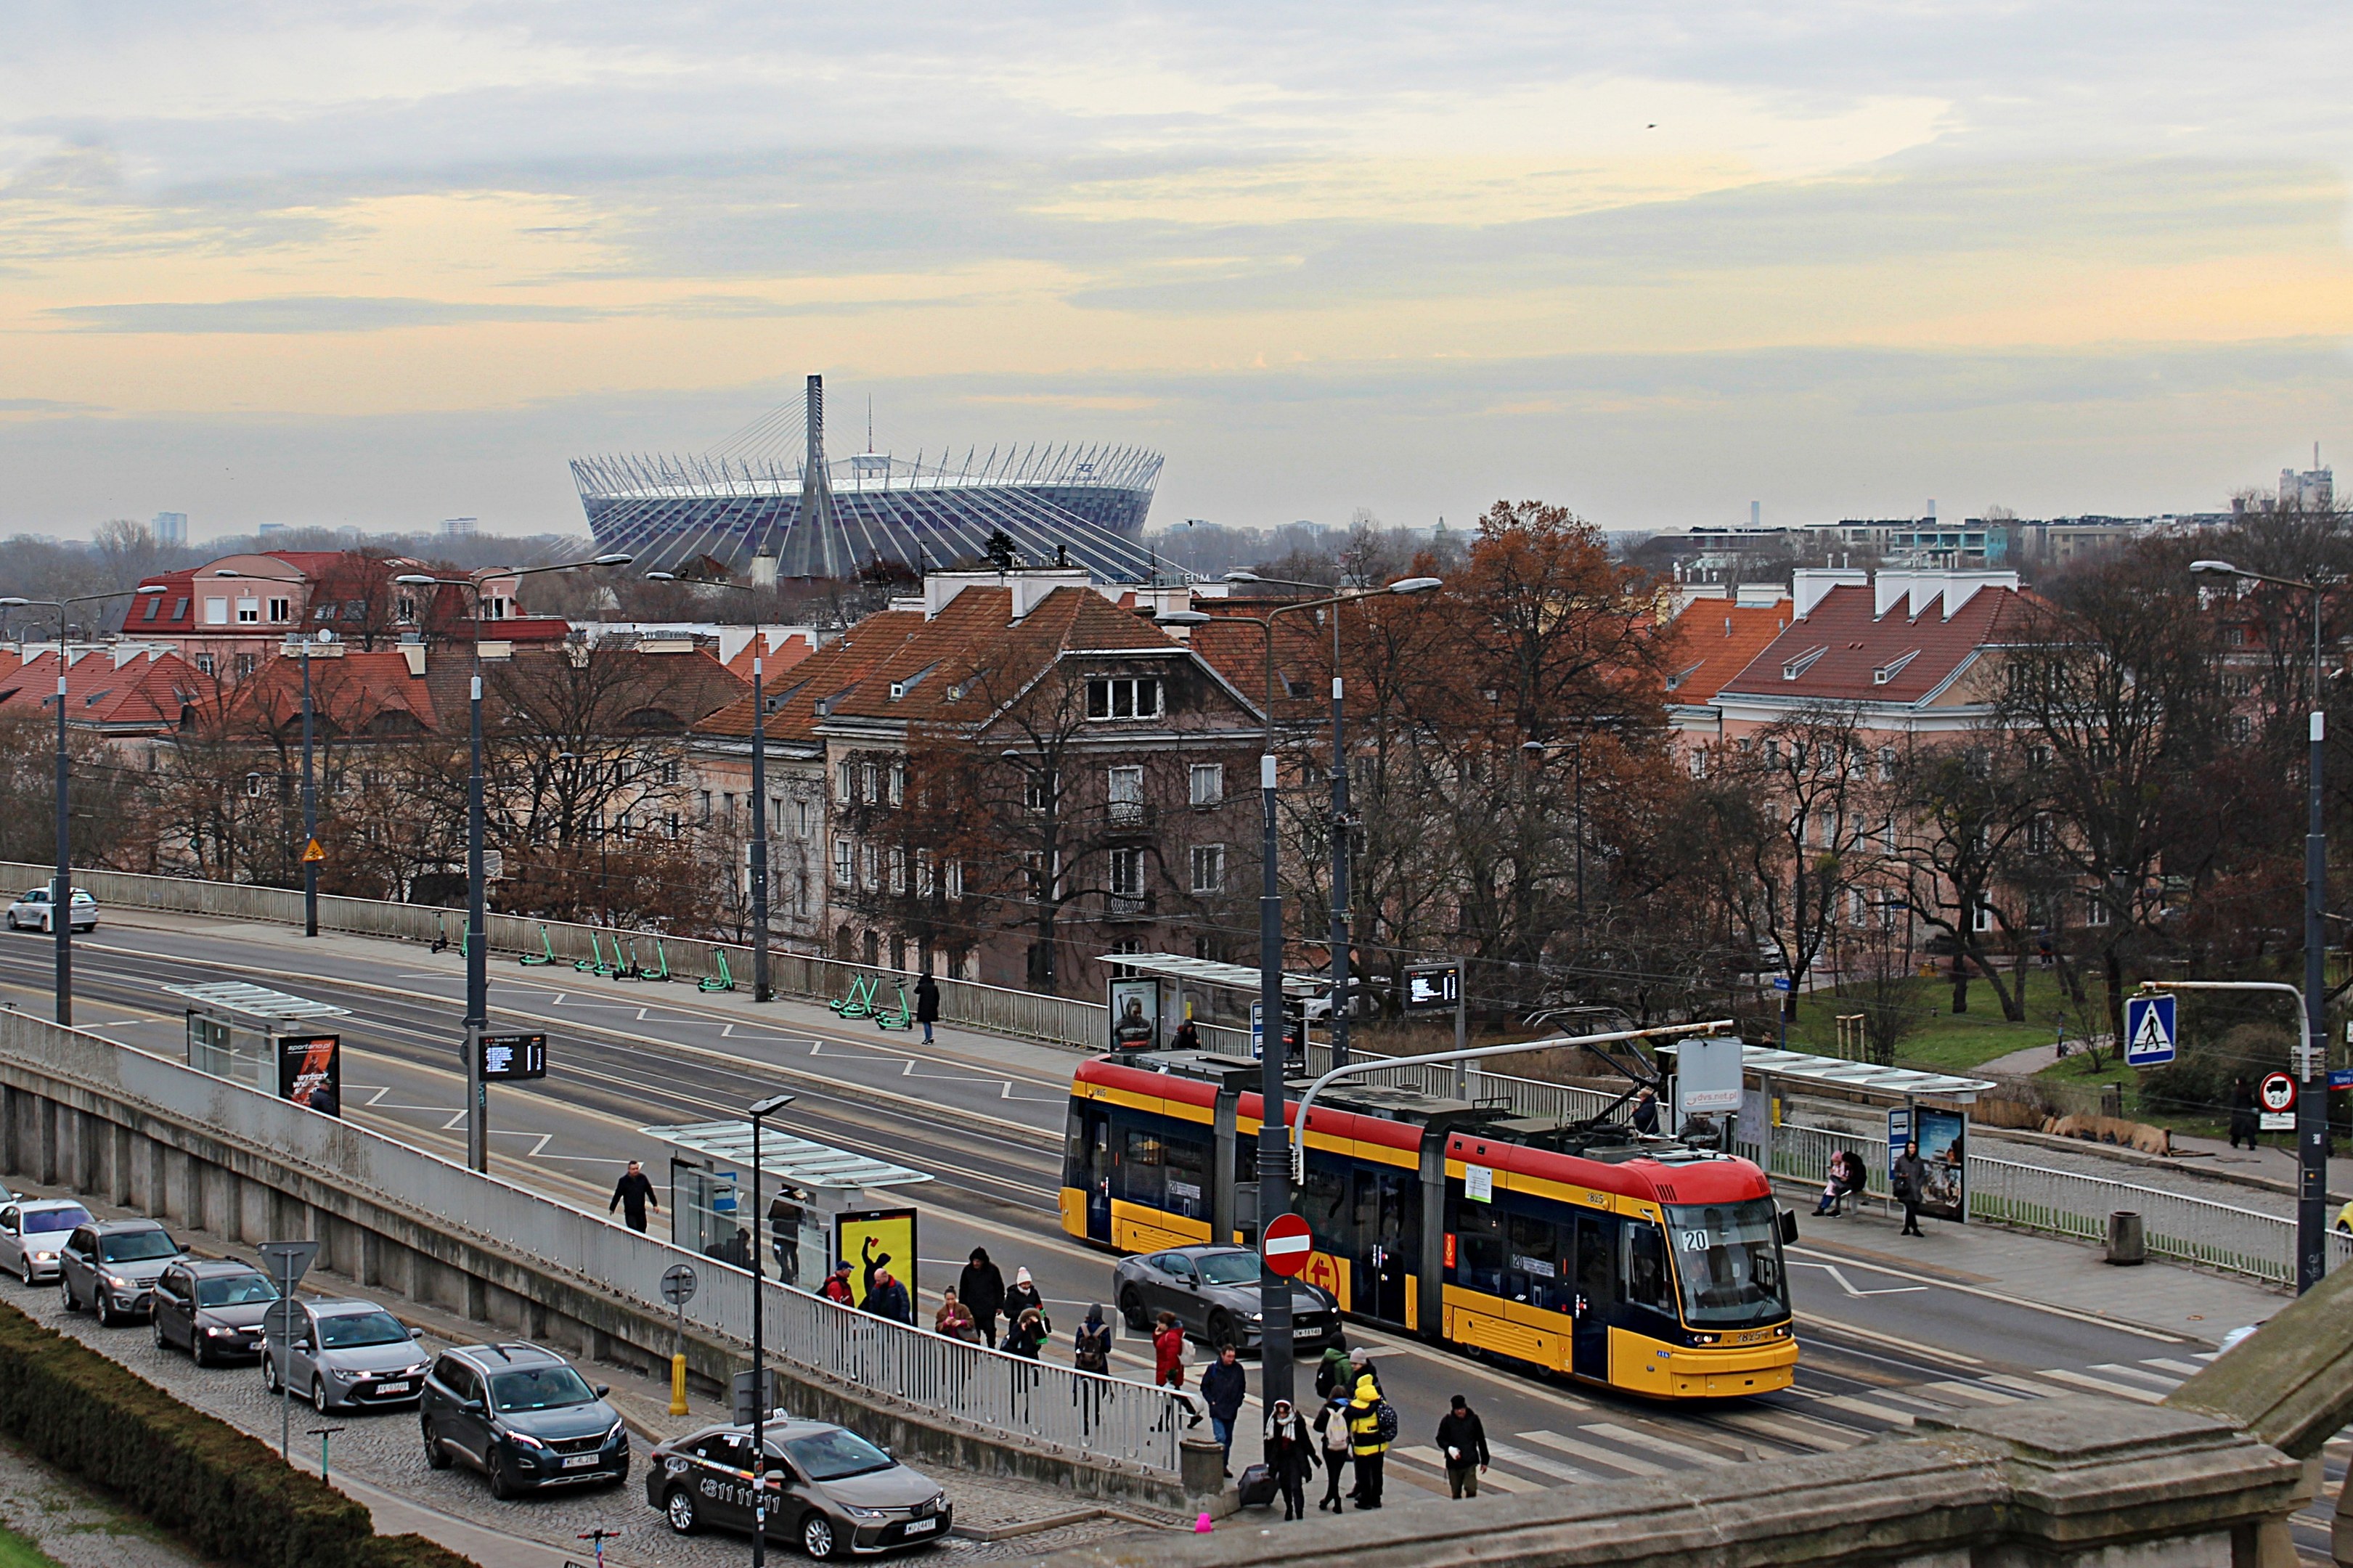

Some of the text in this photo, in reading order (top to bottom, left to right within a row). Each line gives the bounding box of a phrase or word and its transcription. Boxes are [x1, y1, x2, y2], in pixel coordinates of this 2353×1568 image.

[1685, 1230, 1706, 1249] 20
[1514, 1254, 1524, 1268] 20
[704, 1479, 733, 1502] 811
[738, 1488, 753, 1506] 11
